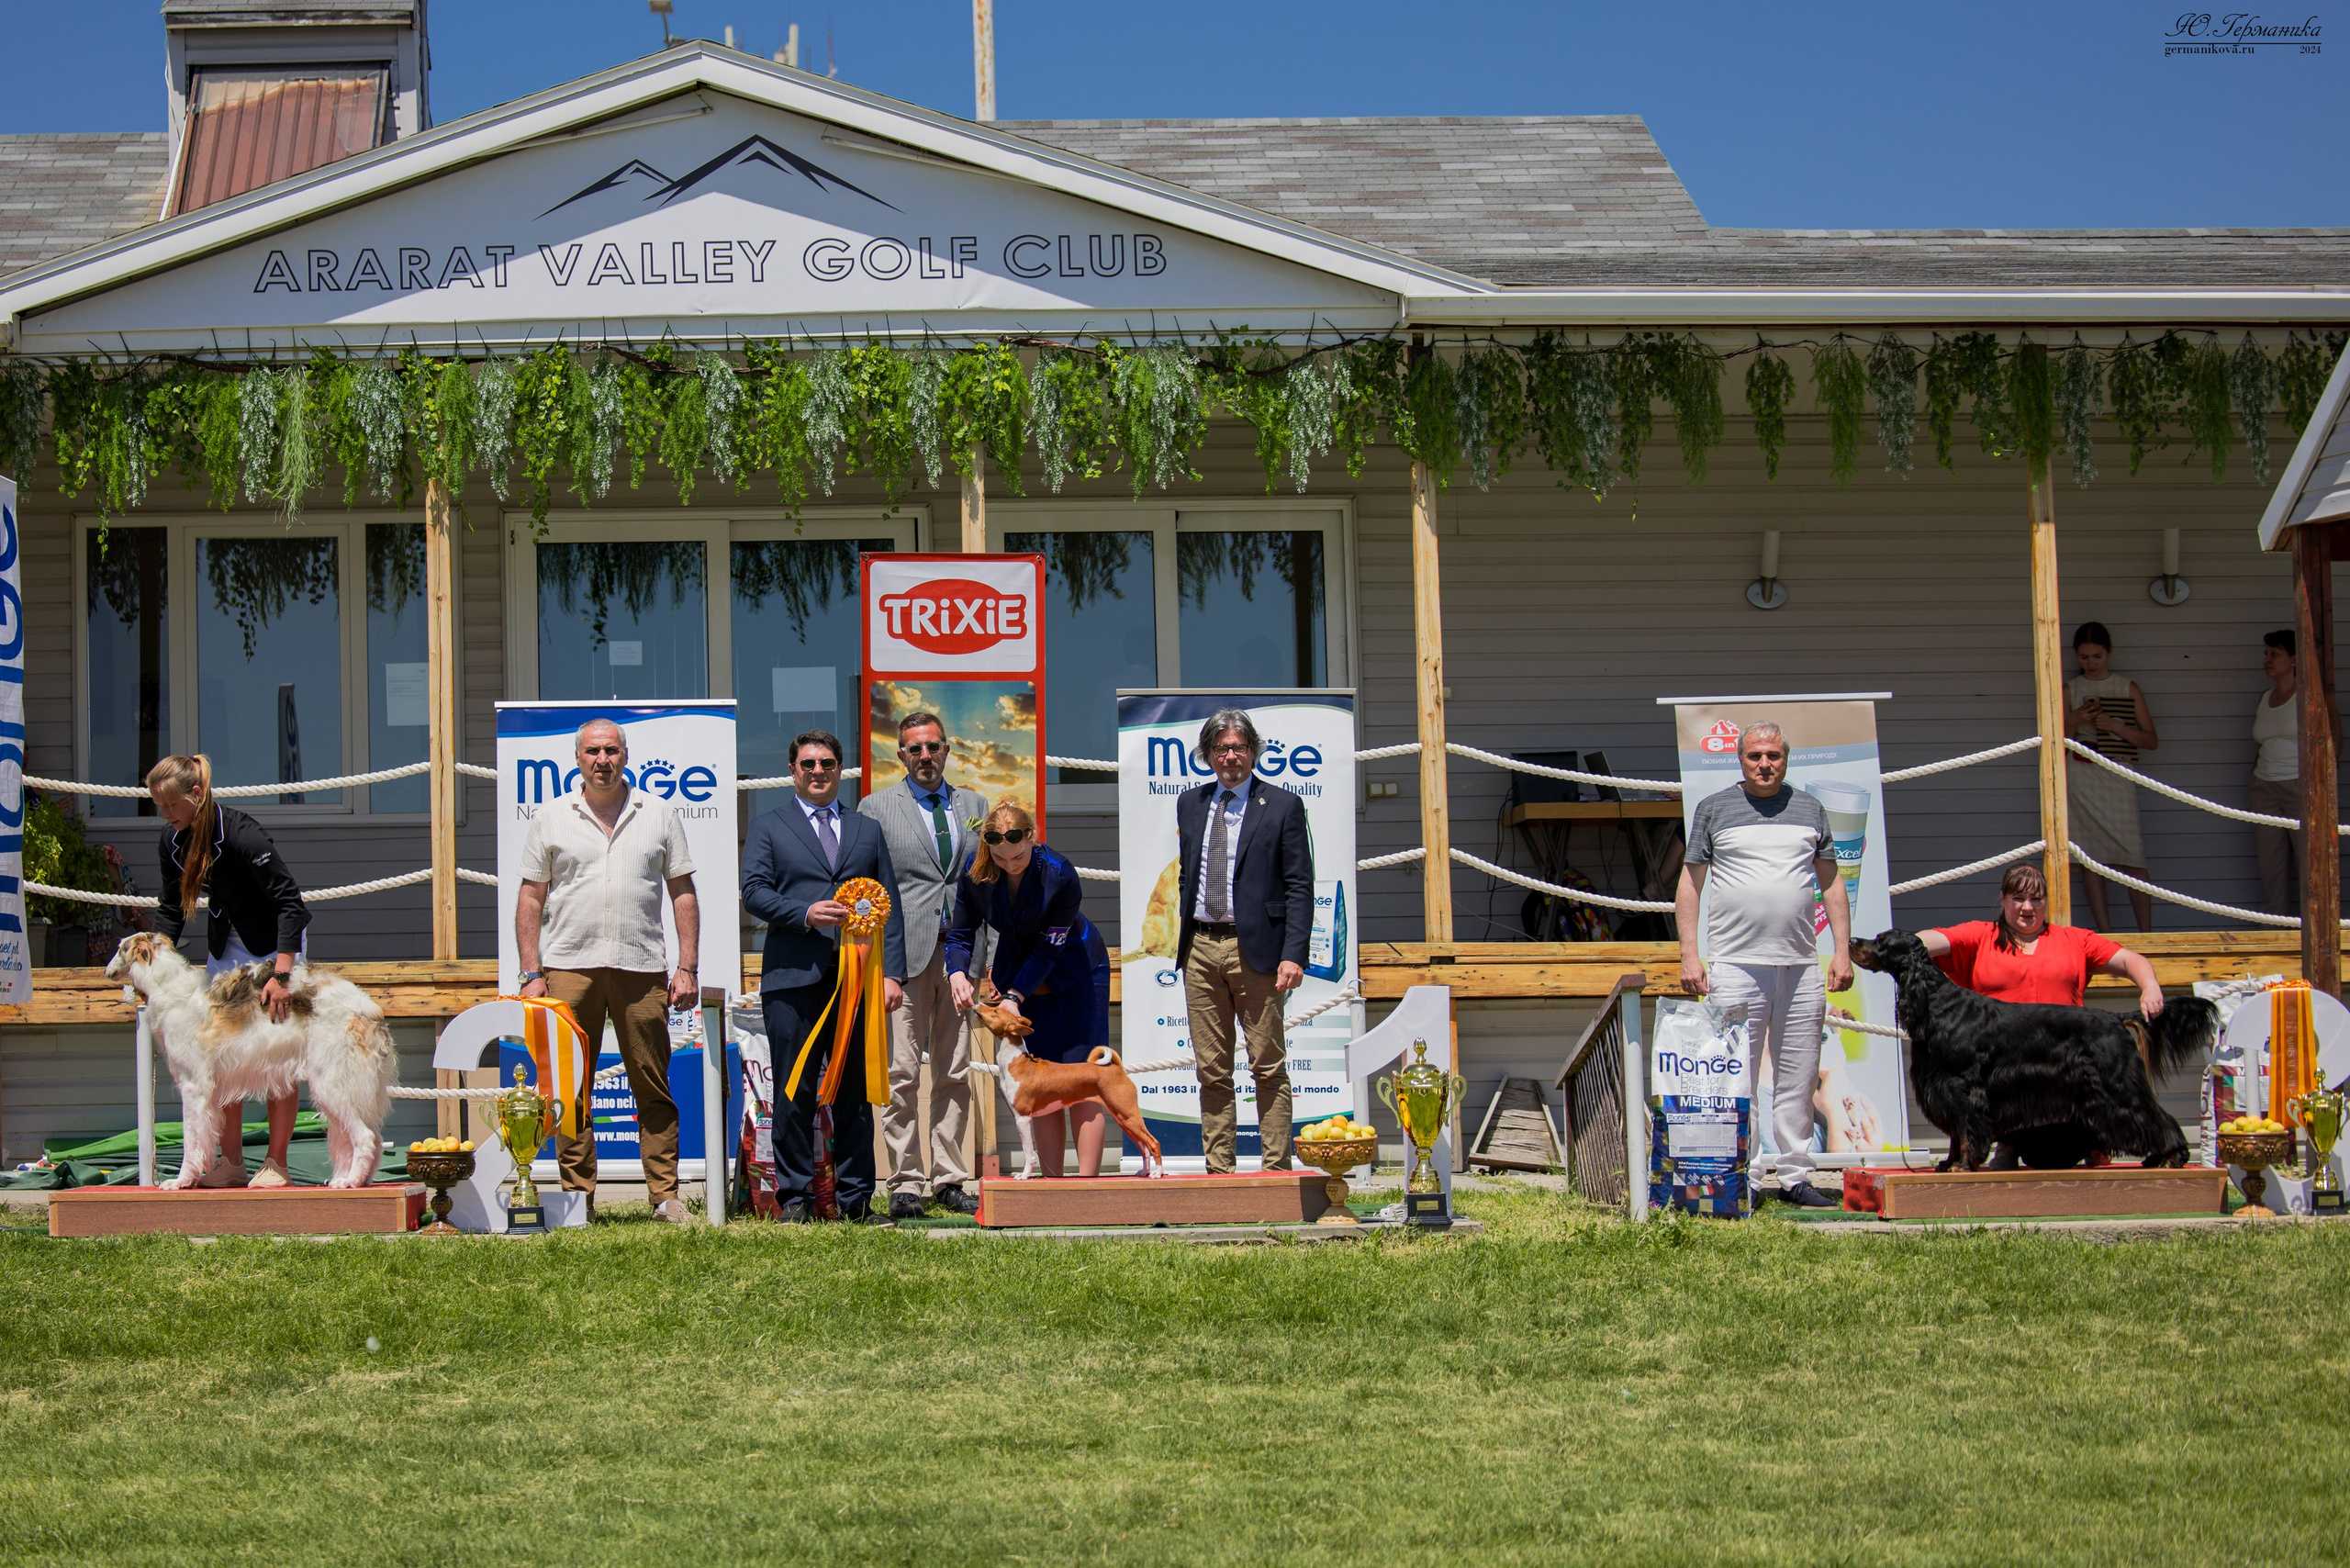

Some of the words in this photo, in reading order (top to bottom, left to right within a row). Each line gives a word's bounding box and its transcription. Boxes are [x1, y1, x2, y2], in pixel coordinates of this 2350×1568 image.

[252, 245, 515, 293] ARARAT
[537, 240, 778, 286] VALLEY
[802, 236, 978, 282] GOLF
[1002, 233, 1167, 278] CLUB
[1148, 781, 1191, 795] Natural
[1292, 1059, 1312, 1070] FREE
[1680, 1072, 1705, 1086] Best
[1707, 1075, 1721, 1085] for
[1141, 1085, 1158, 1094] Dal
[1161, 1085, 1188, 1094] 1963
[1190, 1085, 1197, 1094] il
[1304, 1085, 1339, 1094] mondo
[1680, 1082, 1729, 1095] Breeders
[616, 1095, 633, 1109] nel
[1680, 1096, 1737, 1109] MEDIUM
